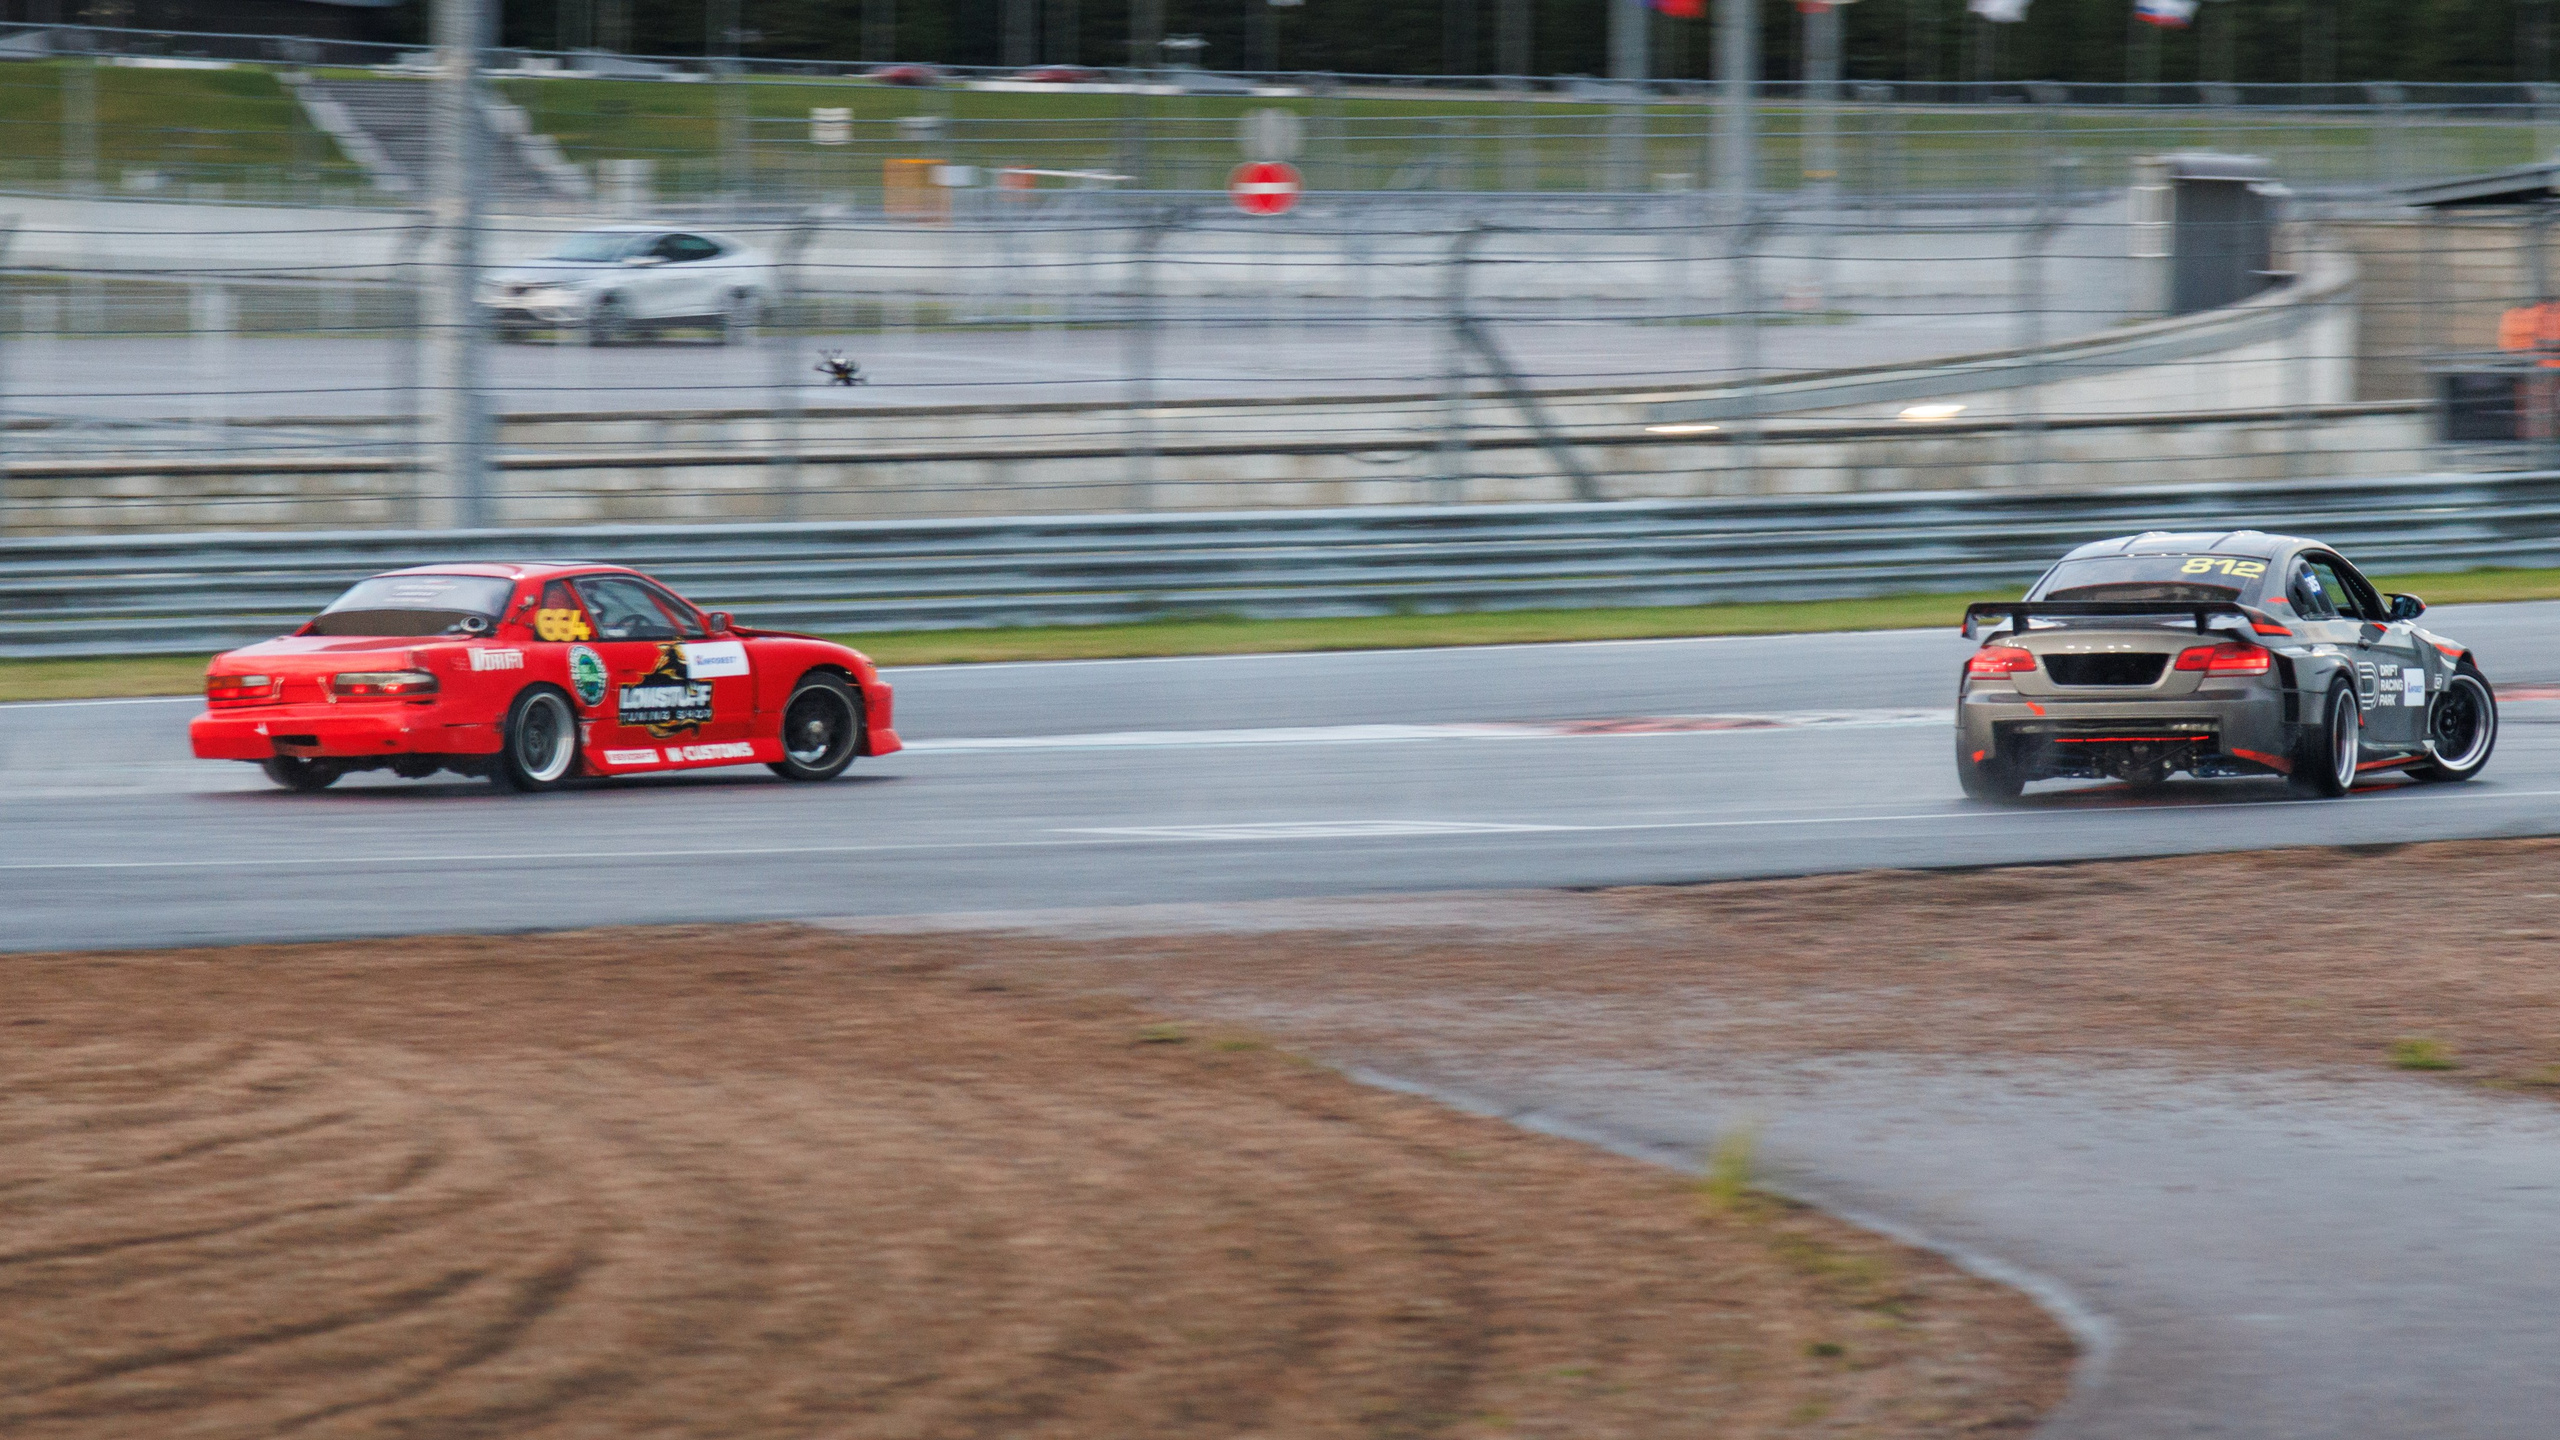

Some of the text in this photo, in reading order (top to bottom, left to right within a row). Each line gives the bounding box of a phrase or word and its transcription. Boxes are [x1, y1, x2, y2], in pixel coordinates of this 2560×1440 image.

[2181, 558, 2266, 579] 812
[2379, 664, 2398, 677] DRIFT
[2380, 679, 2404, 692] RACING
[2379, 694, 2397, 706] PARK
[676, 709, 713, 720] SHOP
